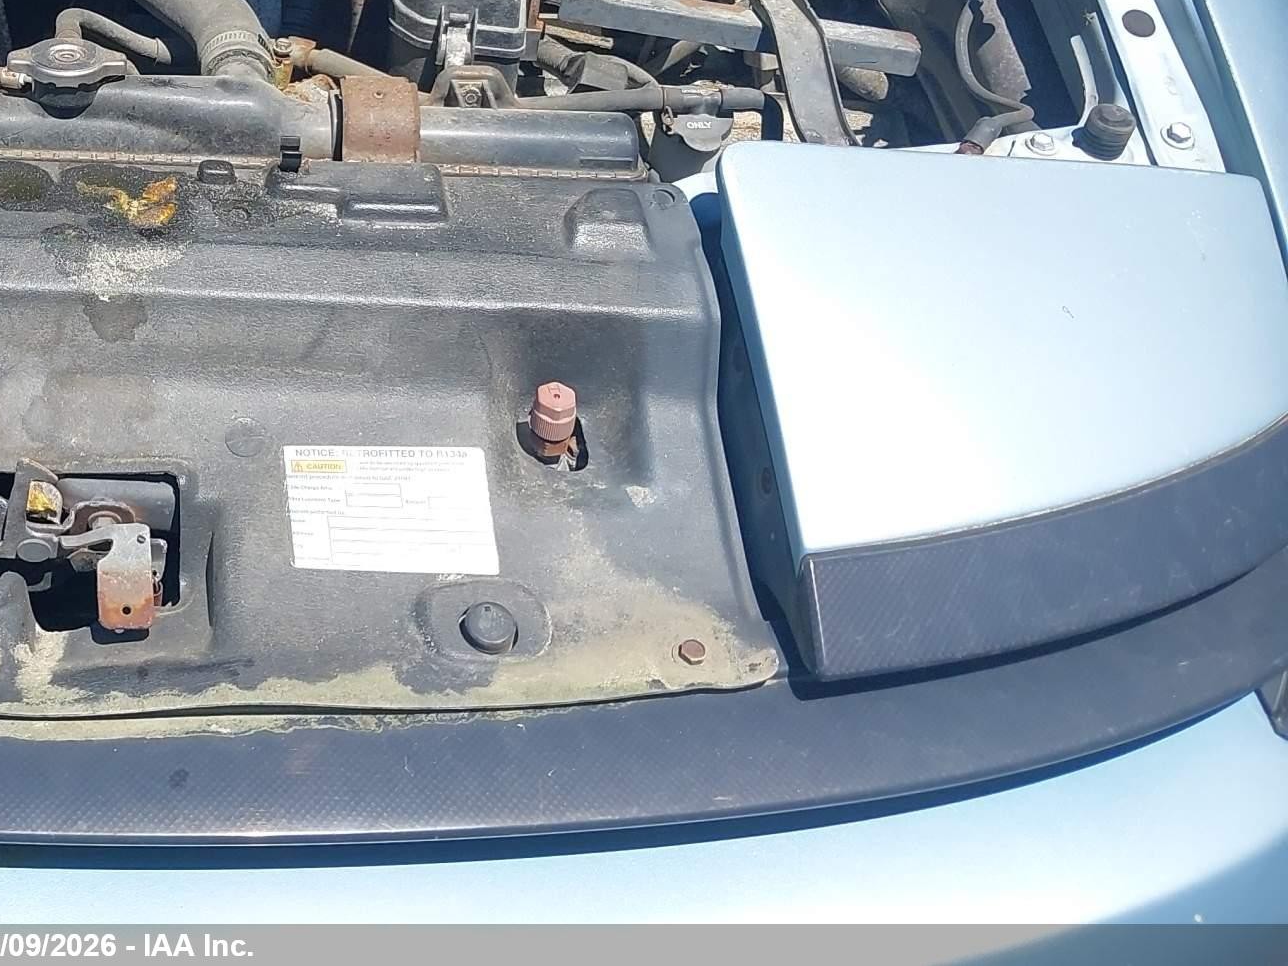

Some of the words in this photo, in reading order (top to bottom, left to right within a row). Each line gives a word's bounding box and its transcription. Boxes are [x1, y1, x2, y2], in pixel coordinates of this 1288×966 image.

[686, 121, 712, 129] ONLY
[419, 450, 433, 459] TO
[306, 462, 342, 470] CAUTION
